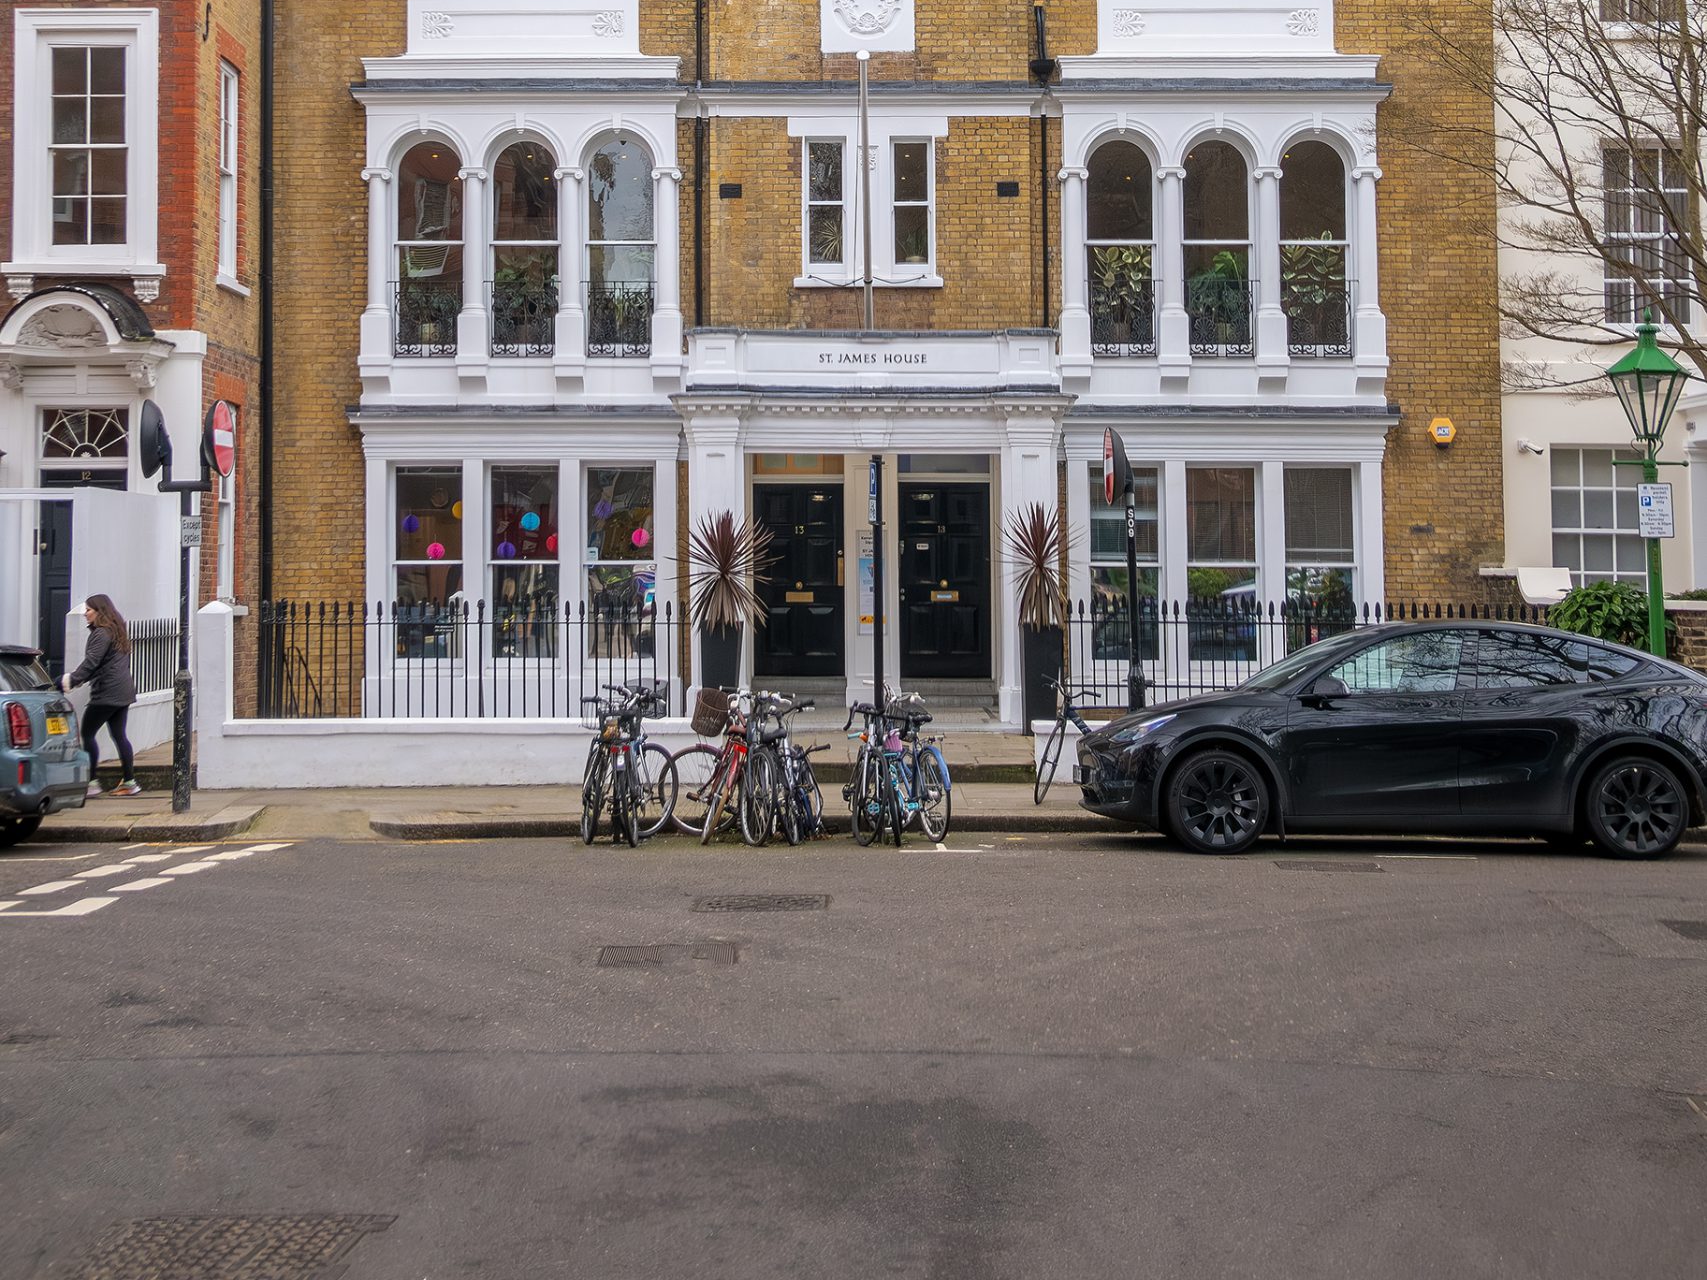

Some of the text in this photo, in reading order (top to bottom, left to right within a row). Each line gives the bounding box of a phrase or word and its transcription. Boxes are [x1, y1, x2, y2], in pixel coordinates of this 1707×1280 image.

[838, 353, 877, 364] JAMES
[884, 353, 928, 364] HOUSE
[81, 471, 92, 480] 12
[183, 519, 201, 530] Except
[937, 525, 946, 534] 13
[794, 525, 805, 535] 13
[184, 532, 200, 544] cycles
